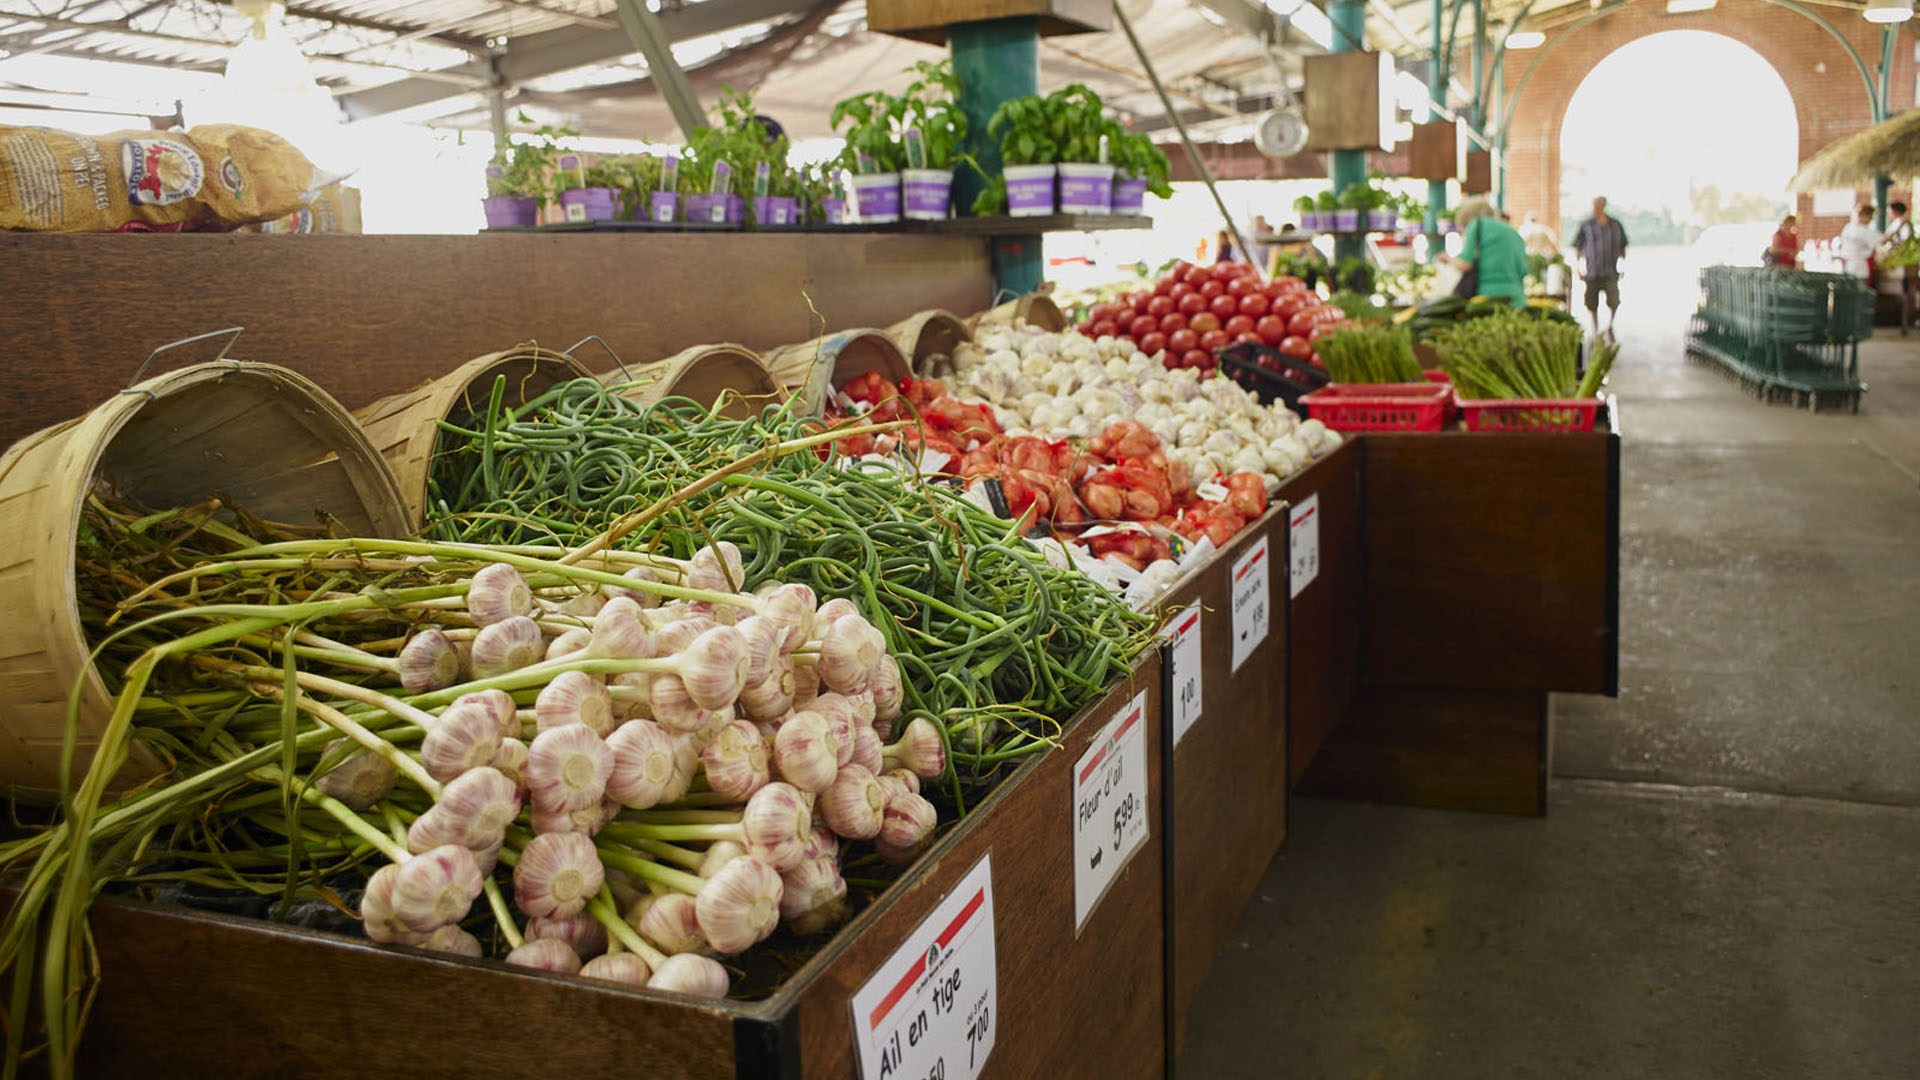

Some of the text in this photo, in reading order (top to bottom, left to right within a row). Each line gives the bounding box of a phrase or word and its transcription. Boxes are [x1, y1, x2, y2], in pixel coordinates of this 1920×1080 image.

[71, 156, 88, 171] ON
[1079, 788, 1101, 832] Fleur
[1104, 755, 1123, 797] d'ail
[1113, 791, 1134, 851] 599
[880, 1030, 902, 1080] Ail
[909, 1009, 928, 1047] en
[932, 967, 961, 1016] tige
[967, 1007, 989, 1070] 700
